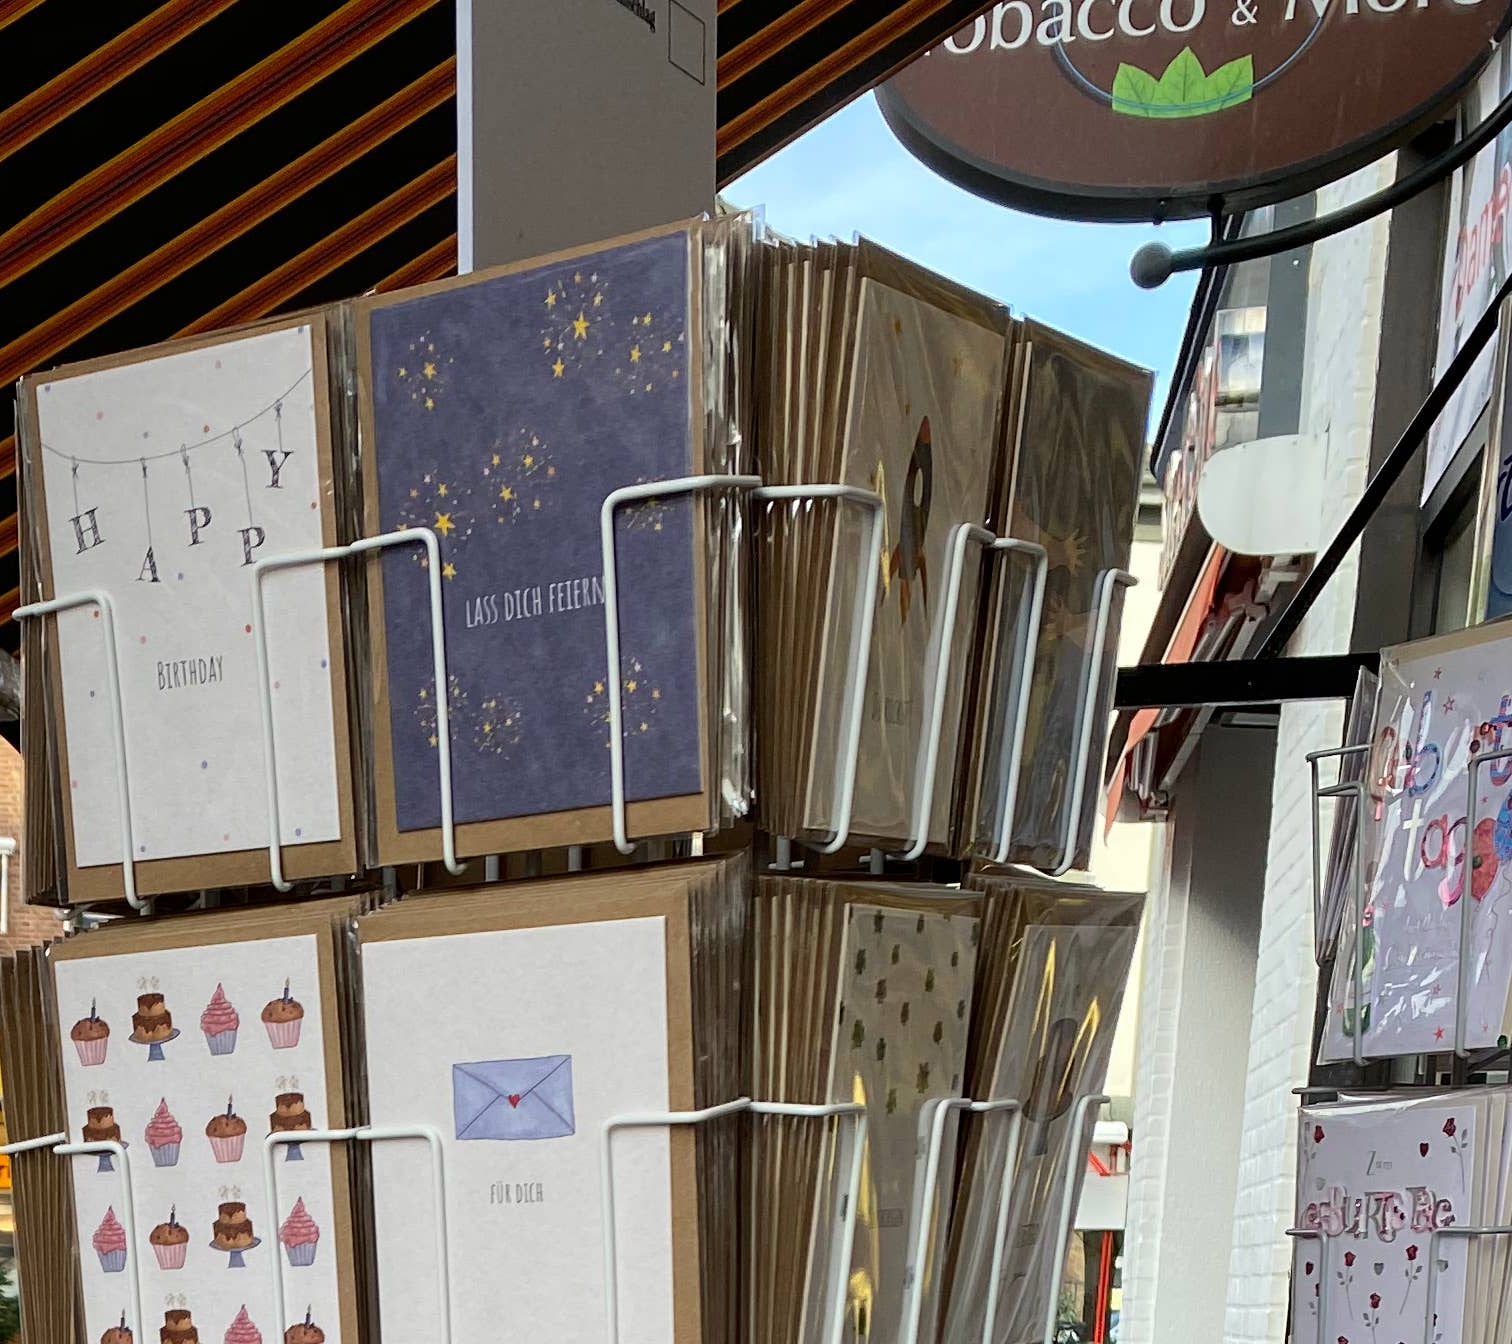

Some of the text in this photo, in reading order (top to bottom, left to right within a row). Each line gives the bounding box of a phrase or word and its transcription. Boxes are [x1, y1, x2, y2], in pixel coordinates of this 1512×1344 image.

[923, 0, 1206, 57] obacco
[68, 449, 295, 583] HAPPY
[465, 575, 606, 628] LASS DICH FEIERN
[156, 655, 224, 690] BIRTHDAY
[490, 1180, 544, 1205] FÜR DICH
